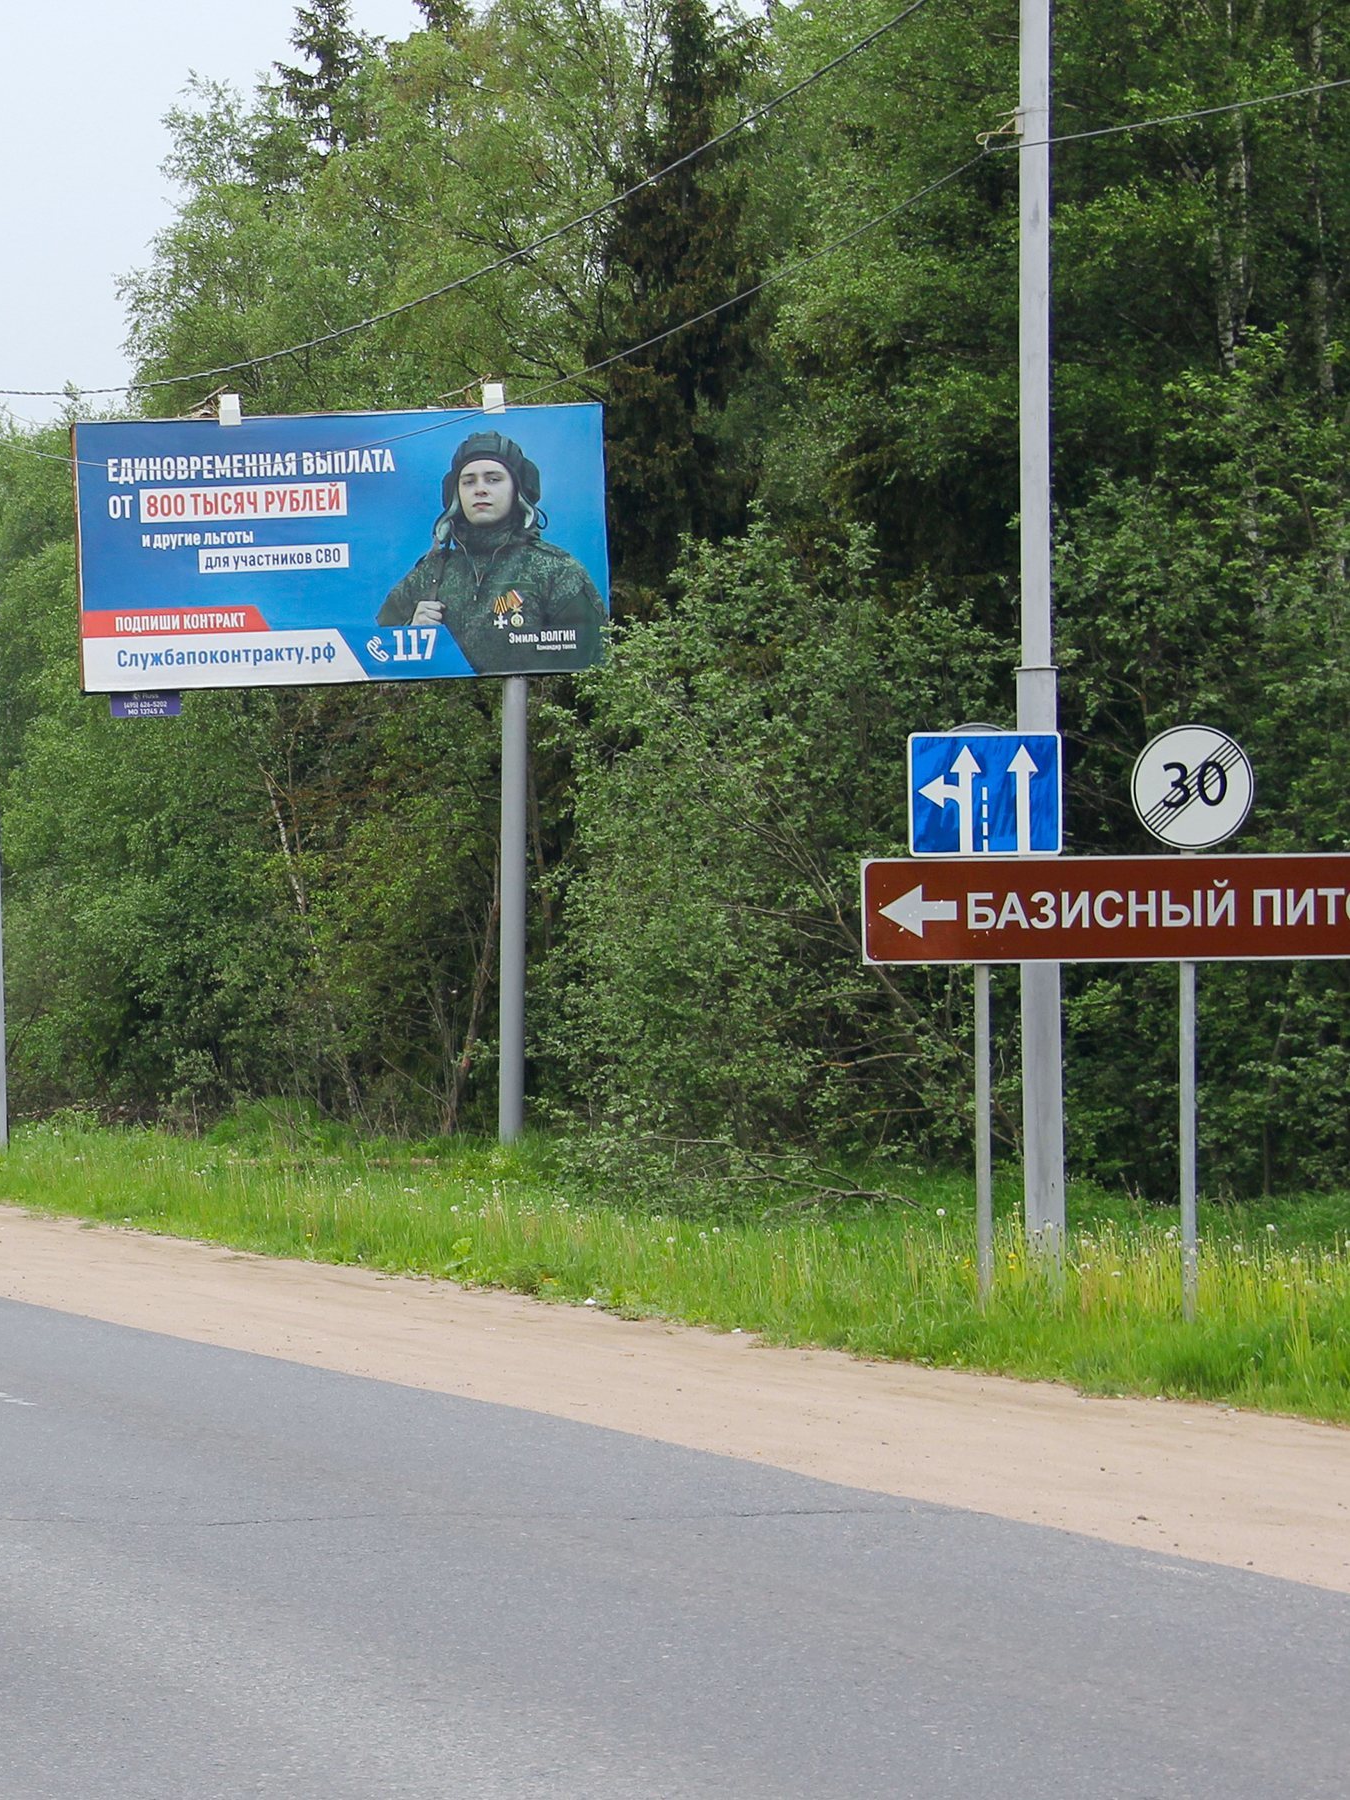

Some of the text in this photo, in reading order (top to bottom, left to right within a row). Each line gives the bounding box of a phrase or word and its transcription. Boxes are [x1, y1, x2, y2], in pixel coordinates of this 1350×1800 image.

[107, 449, 396, 485] ЕДИНОВРЕМЕННАЯ ВЫПЛАТА
[108, 483, 341, 519] ОТ 800 ТЫСЯЧ РУБЛЕЙ
[142, 530, 254, 550] и другие льготы
[205, 548, 341, 570] для участников СВО
[115, 612, 246, 634] ПОДПИШИ КОНТРАКТ
[508, 629, 576, 644] Эмиль ВОЛГИН
[117, 642, 336, 671] Службапоконтракту.рф
[392, 629, 437, 662] 117
[1162, 761, 1228, 808] 30
[966, 878, 1350, 930] БАЗИСНЫЙ ПИТ
